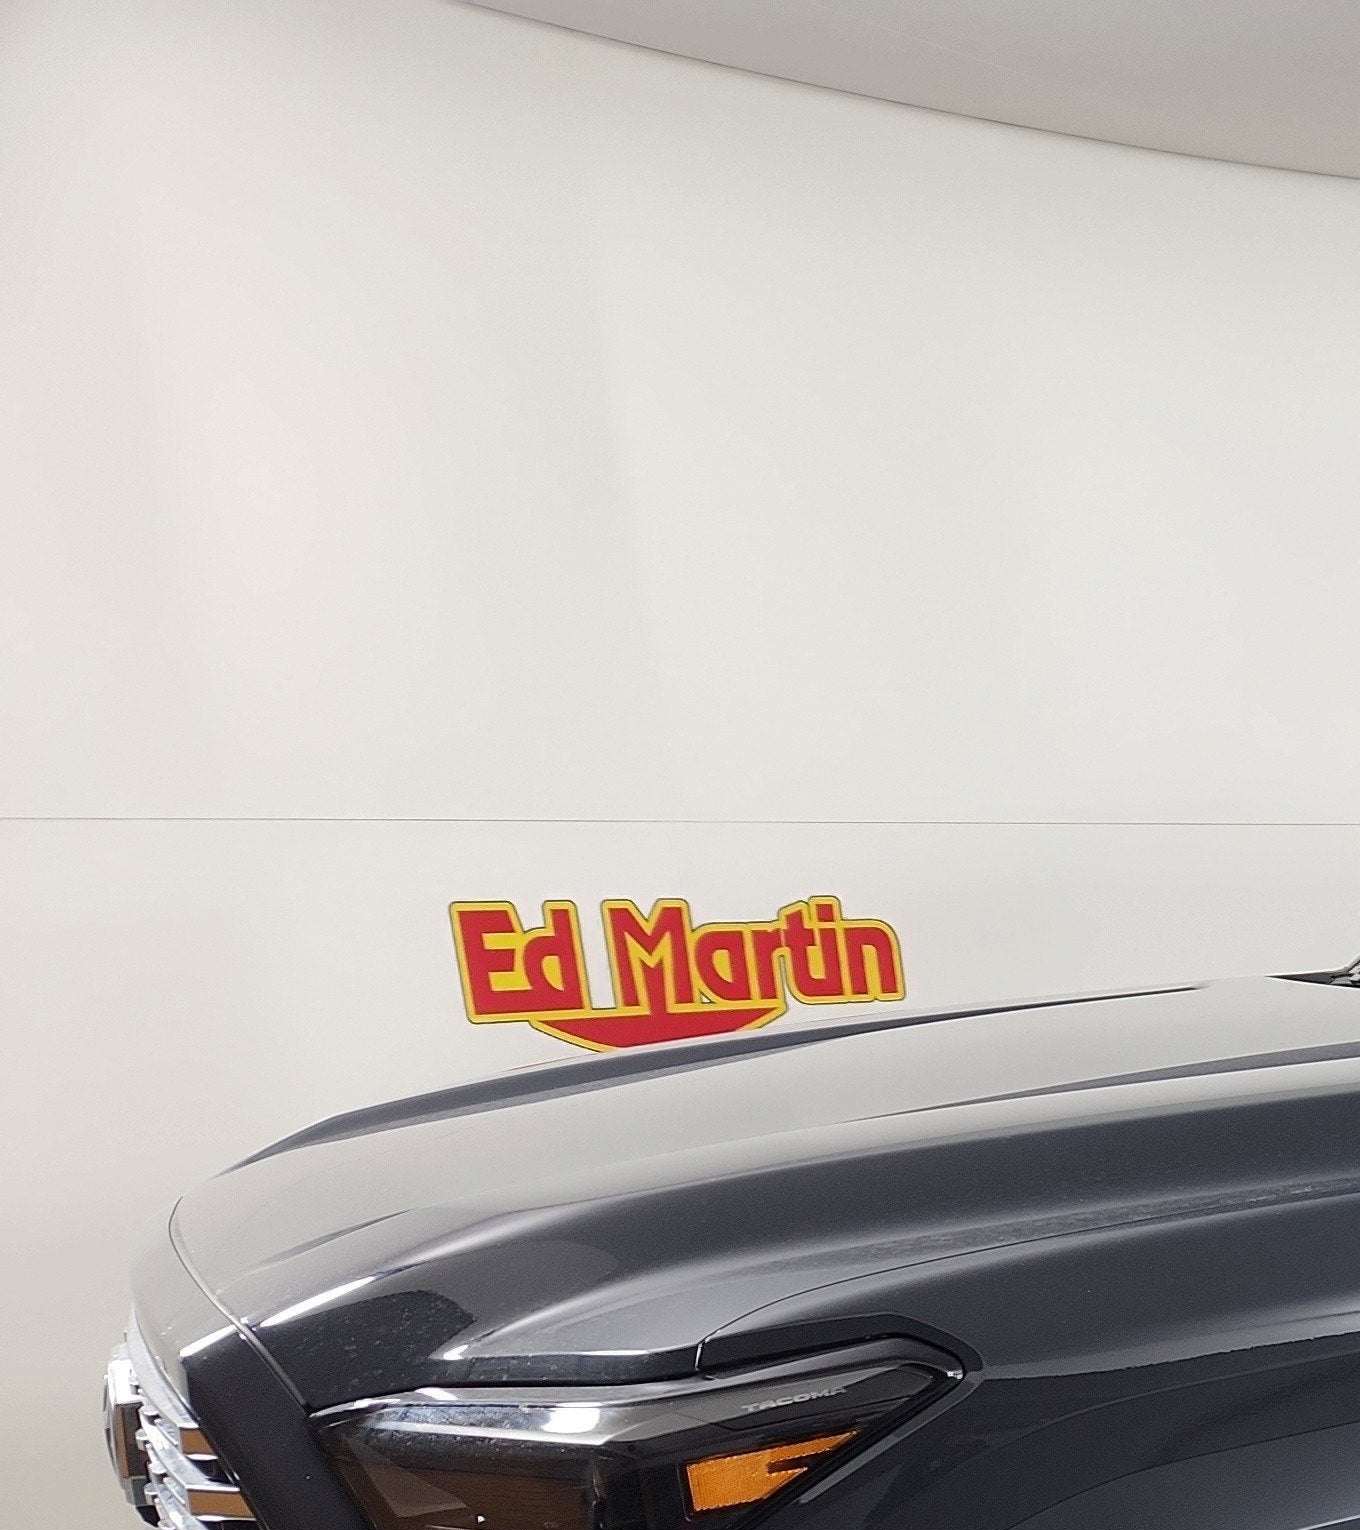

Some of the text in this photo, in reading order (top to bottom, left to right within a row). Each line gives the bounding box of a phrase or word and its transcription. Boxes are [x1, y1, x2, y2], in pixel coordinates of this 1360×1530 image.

[453, 901, 901, 1017] Ed Martin
[740, 1388, 847, 1412] TACOMA
